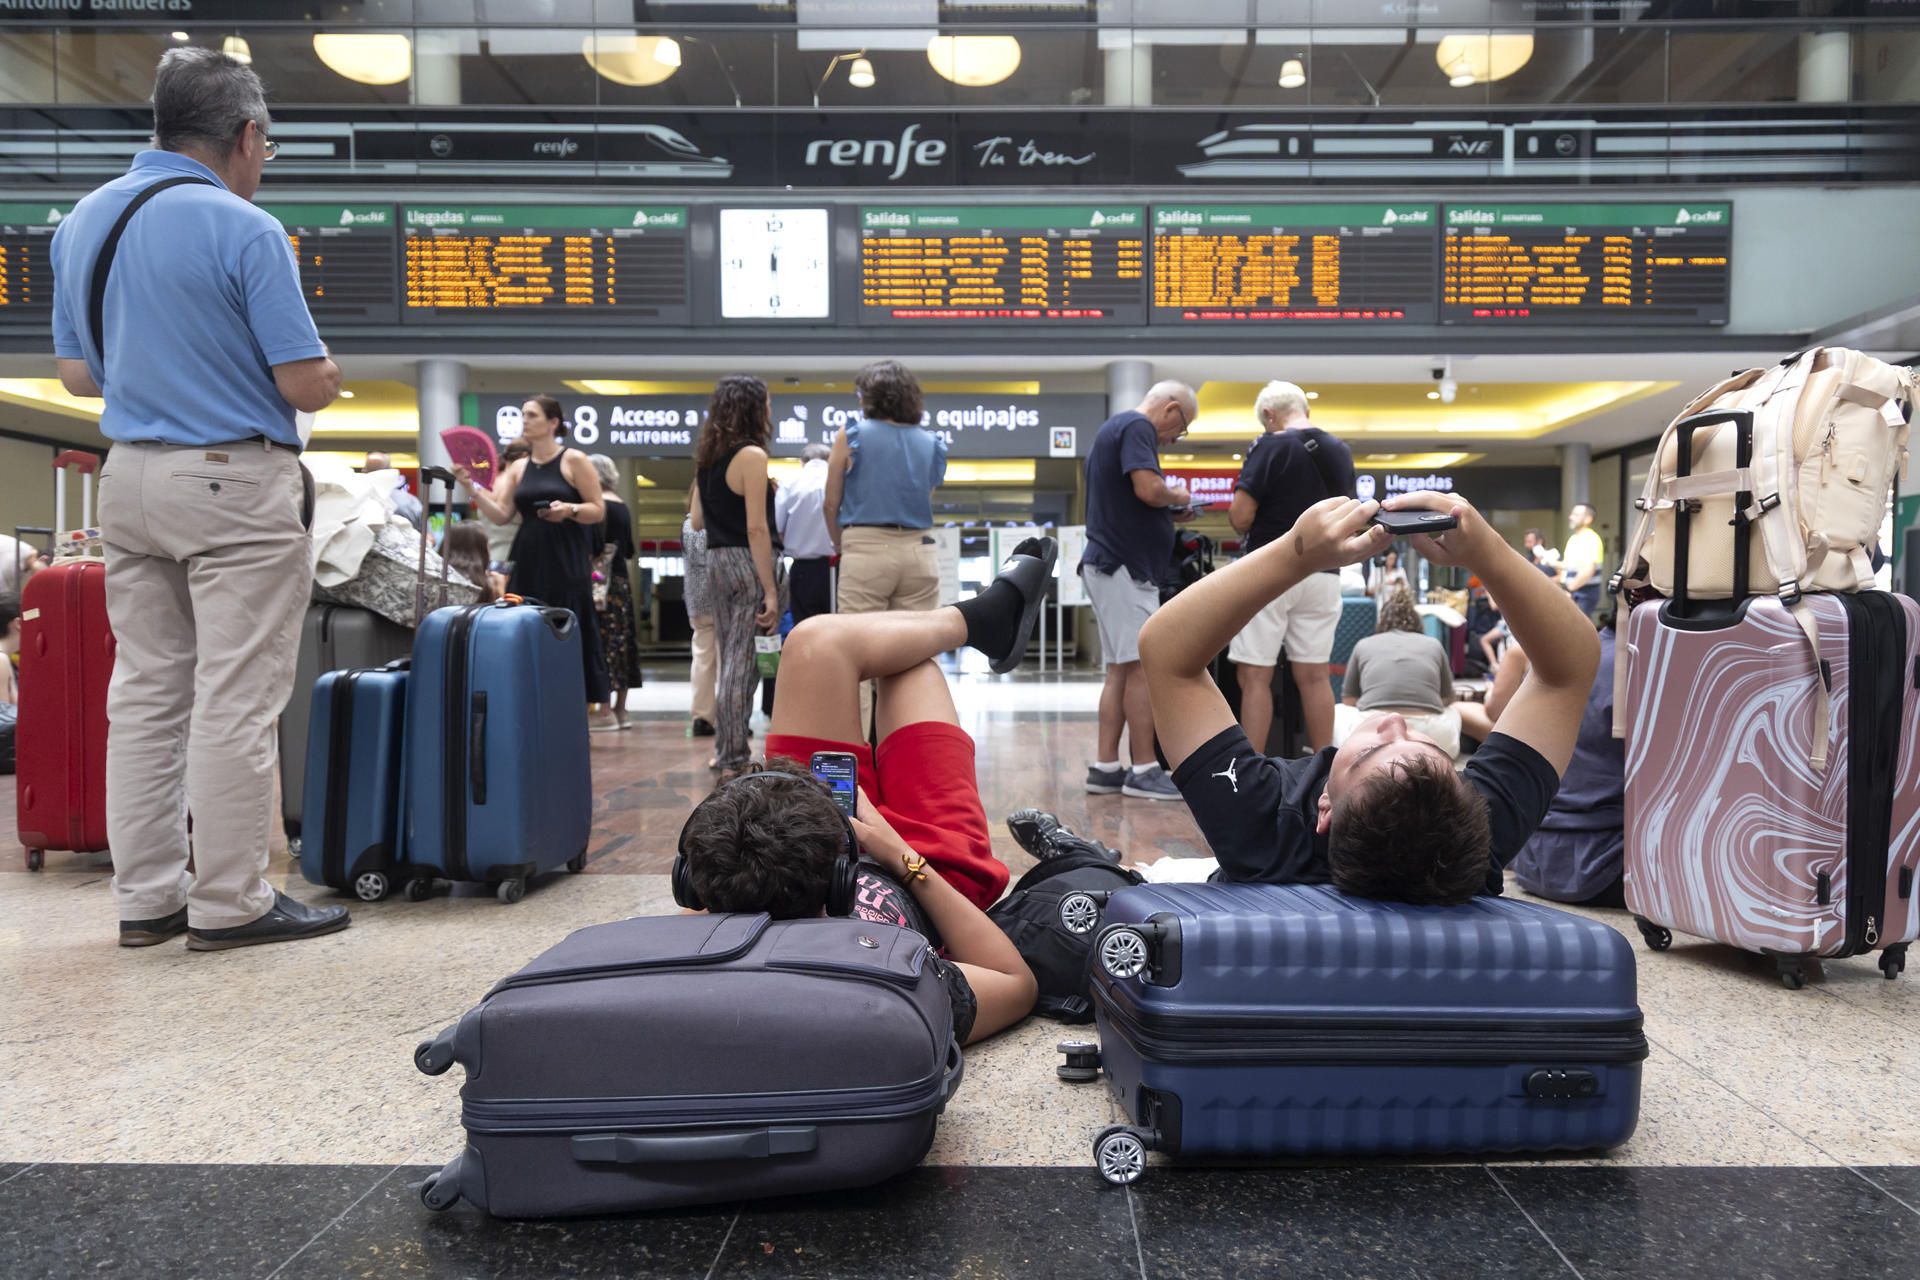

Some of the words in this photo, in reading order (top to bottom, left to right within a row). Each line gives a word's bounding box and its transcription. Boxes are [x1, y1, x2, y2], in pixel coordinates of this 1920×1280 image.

[532, 137, 579, 158] renfe
[804, 123, 947, 181] renfe
[973, 136, 1012, 168] Tu
[1017, 139, 1096, 167] tren
[1447, 140, 1493, 155] AVE
[407, 210, 465, 227] Llegadas
[865, 211, 911, 226] Salidas
[1157, 210, 1203, 225] Salidas
[1449, 209, 1495, 223] Salidas
[609, 406, 680, 427] Acceso
[684, 410, 699, 427] a
[936, 405, 1039, 431] equipajes
[610, 430, 691, 444] PLATFORMS
[1190, 477, 1234, 493] pasar
[1385, 474, 1453, 493] Llegadas
